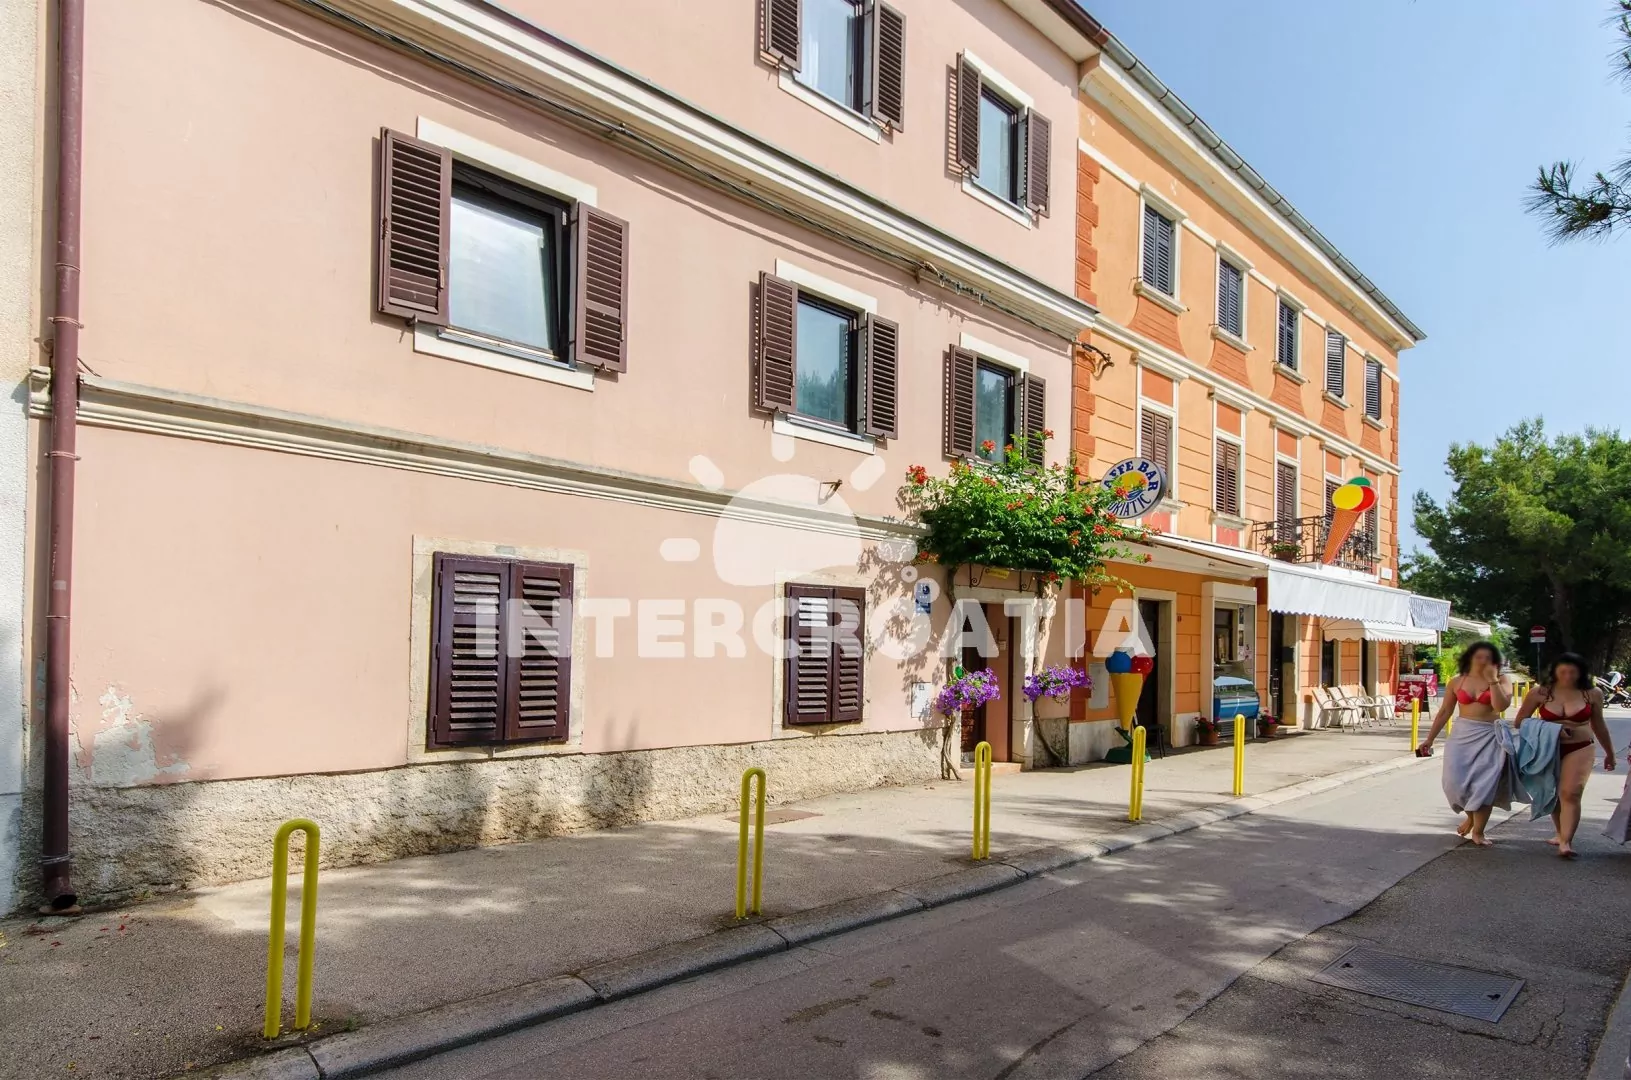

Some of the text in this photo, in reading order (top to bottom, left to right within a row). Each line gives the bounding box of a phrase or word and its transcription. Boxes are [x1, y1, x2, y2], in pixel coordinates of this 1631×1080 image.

[1103, 460, 1159, 491] AFFE BAR
[1107, 493, 1151, 516] DRIATIC
